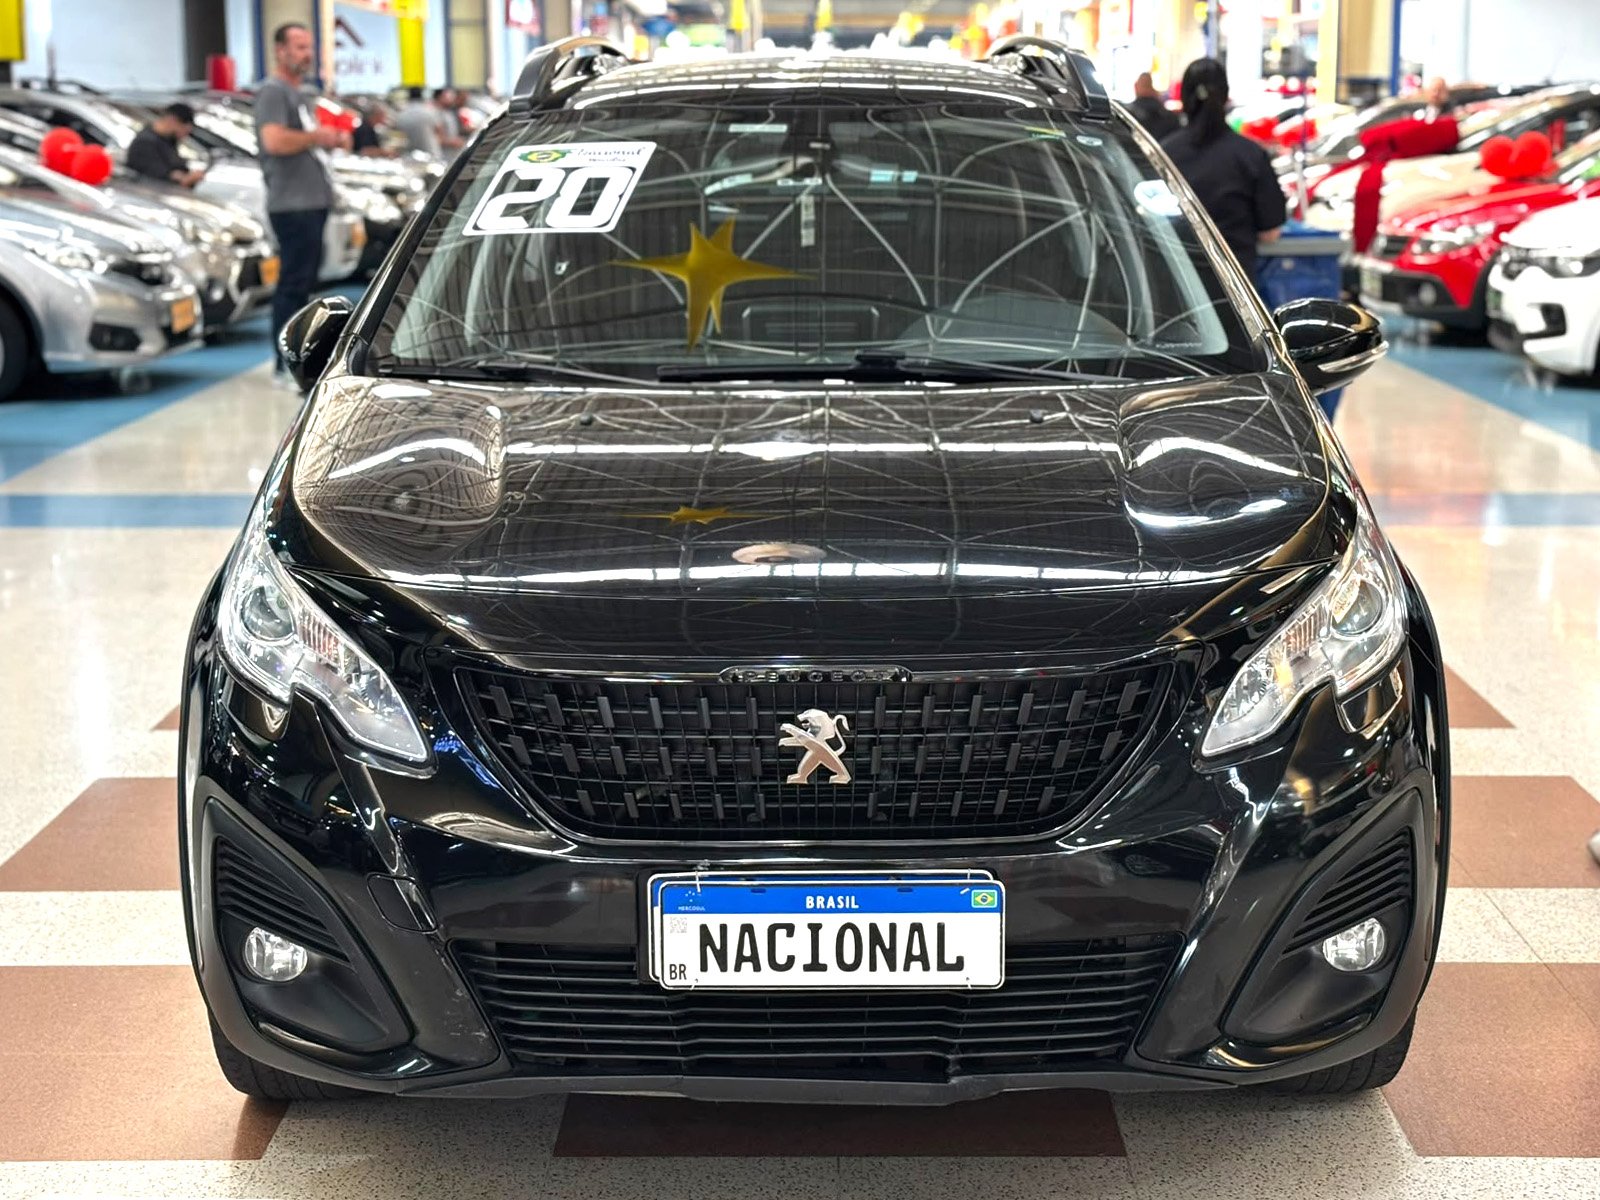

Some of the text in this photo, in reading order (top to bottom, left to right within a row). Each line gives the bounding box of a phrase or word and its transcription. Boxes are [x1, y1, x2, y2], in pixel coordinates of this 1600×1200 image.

[475, 167, 635, 230] 20
[806, 895, 859, 909] BRASIL
[699, 922, 965, 973] NACIONAL
[670, 963, 687, 981] BR
